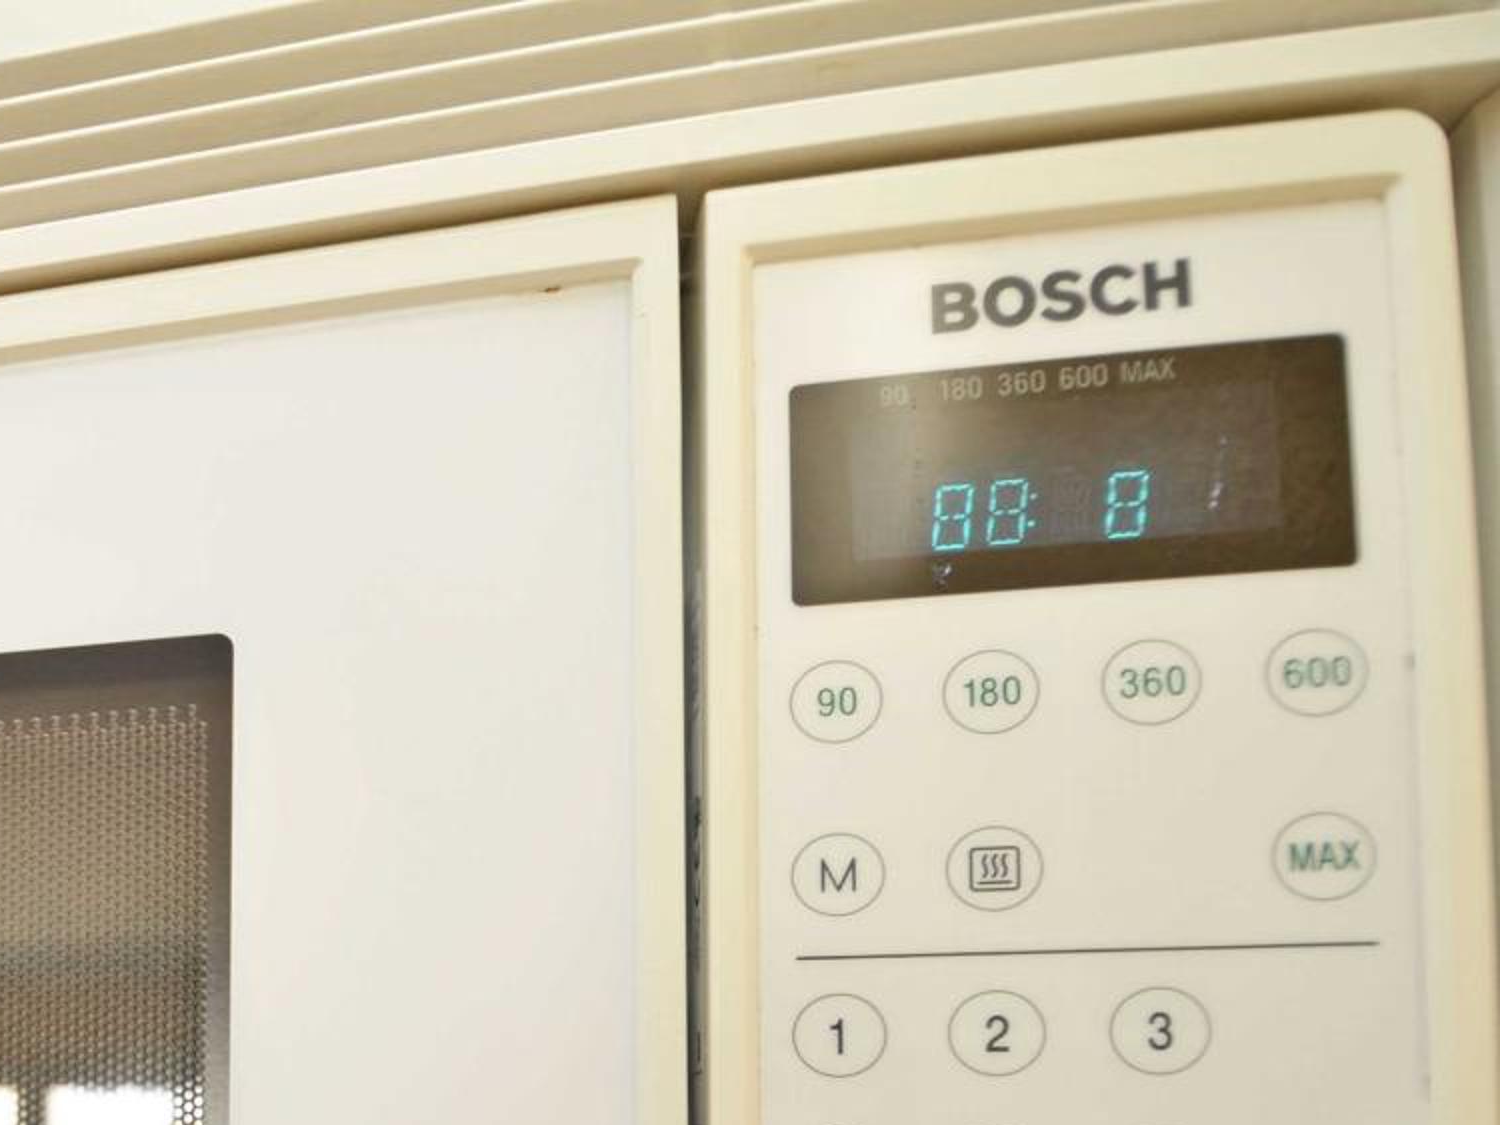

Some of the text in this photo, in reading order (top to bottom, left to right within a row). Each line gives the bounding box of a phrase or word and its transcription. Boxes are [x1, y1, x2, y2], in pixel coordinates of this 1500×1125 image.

[931, 258, 1193, 334] BOSCH
[940, 376, 983, 401] 180
[997, 370, 1046, 397] 360
[1058, 363, 1109, 390] 600
[1120, 356, 1176, 384] MAX
[816, 655, 1353, 717] 90 180 360 600
[820, 841, 1360, 893] M MAX
[829, 1011, 1174, 1055] 1 2 3
